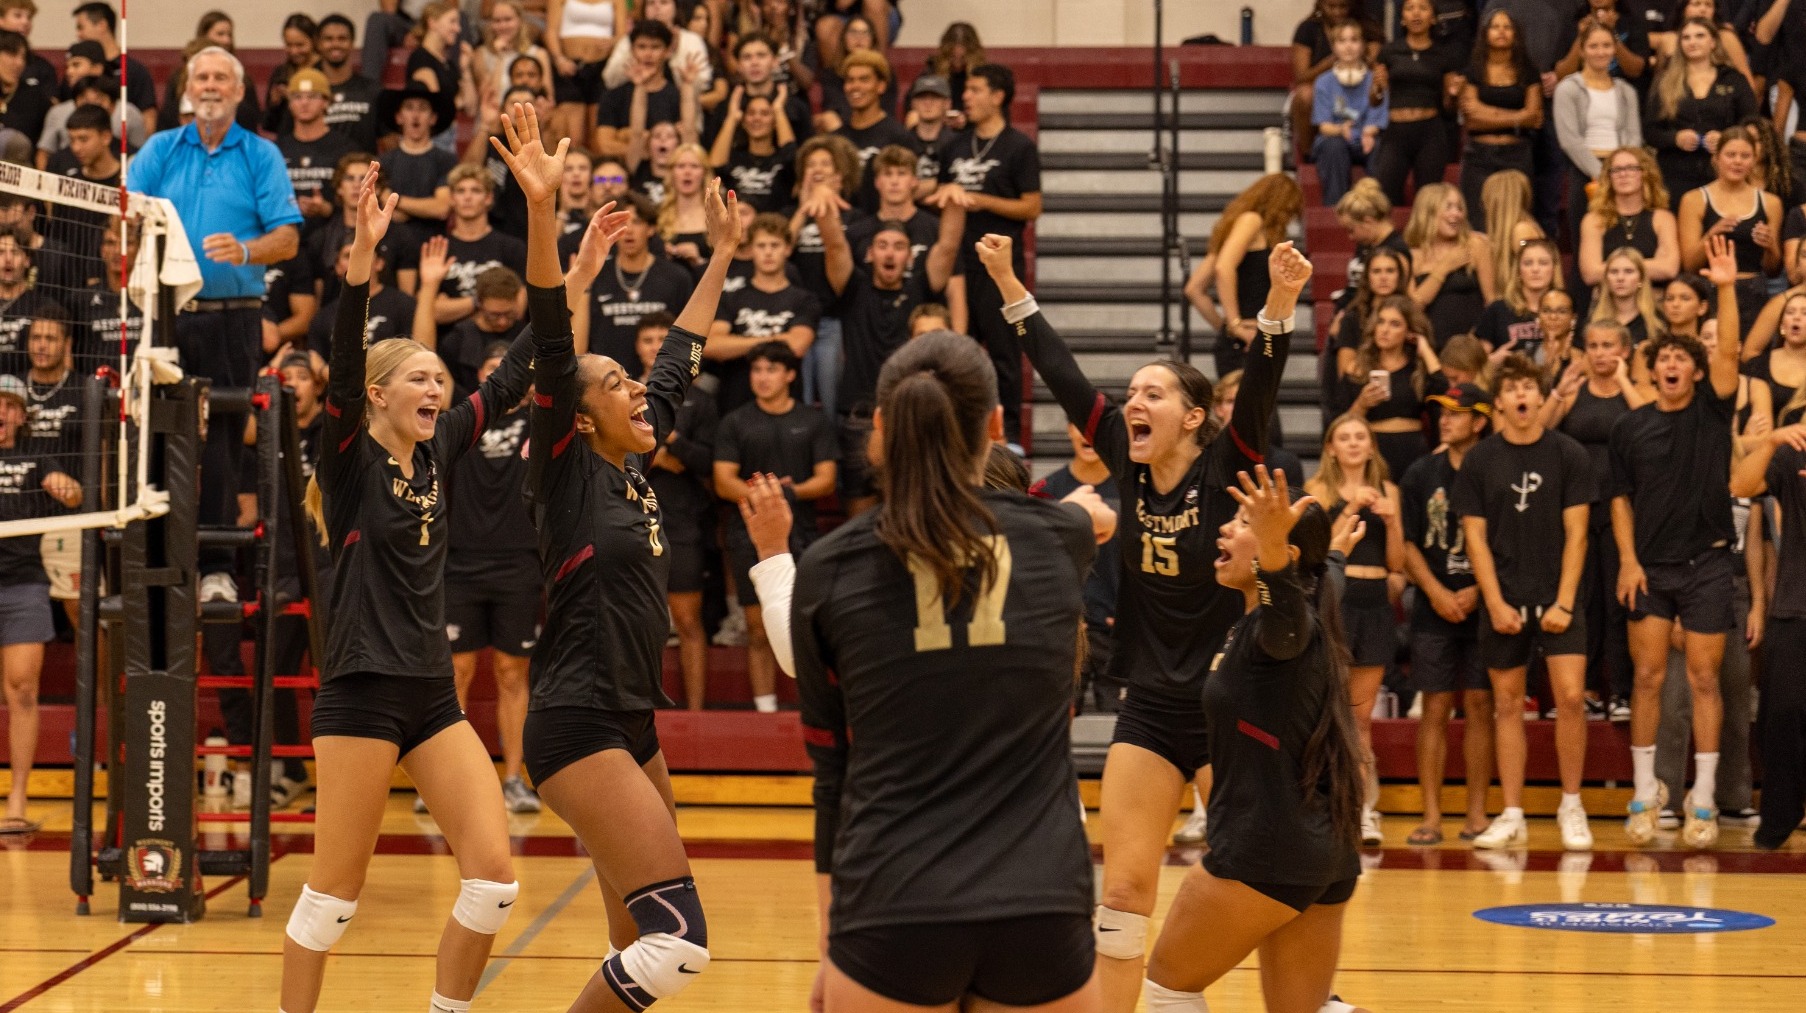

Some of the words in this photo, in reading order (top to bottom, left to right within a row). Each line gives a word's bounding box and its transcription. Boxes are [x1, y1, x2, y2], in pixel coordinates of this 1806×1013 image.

[1140, 531, 1181, 577] 15
[907, 534, 1012, 652] 17
[147, 700, 167, 760] sports
[145, 761, 166, 832] imports
